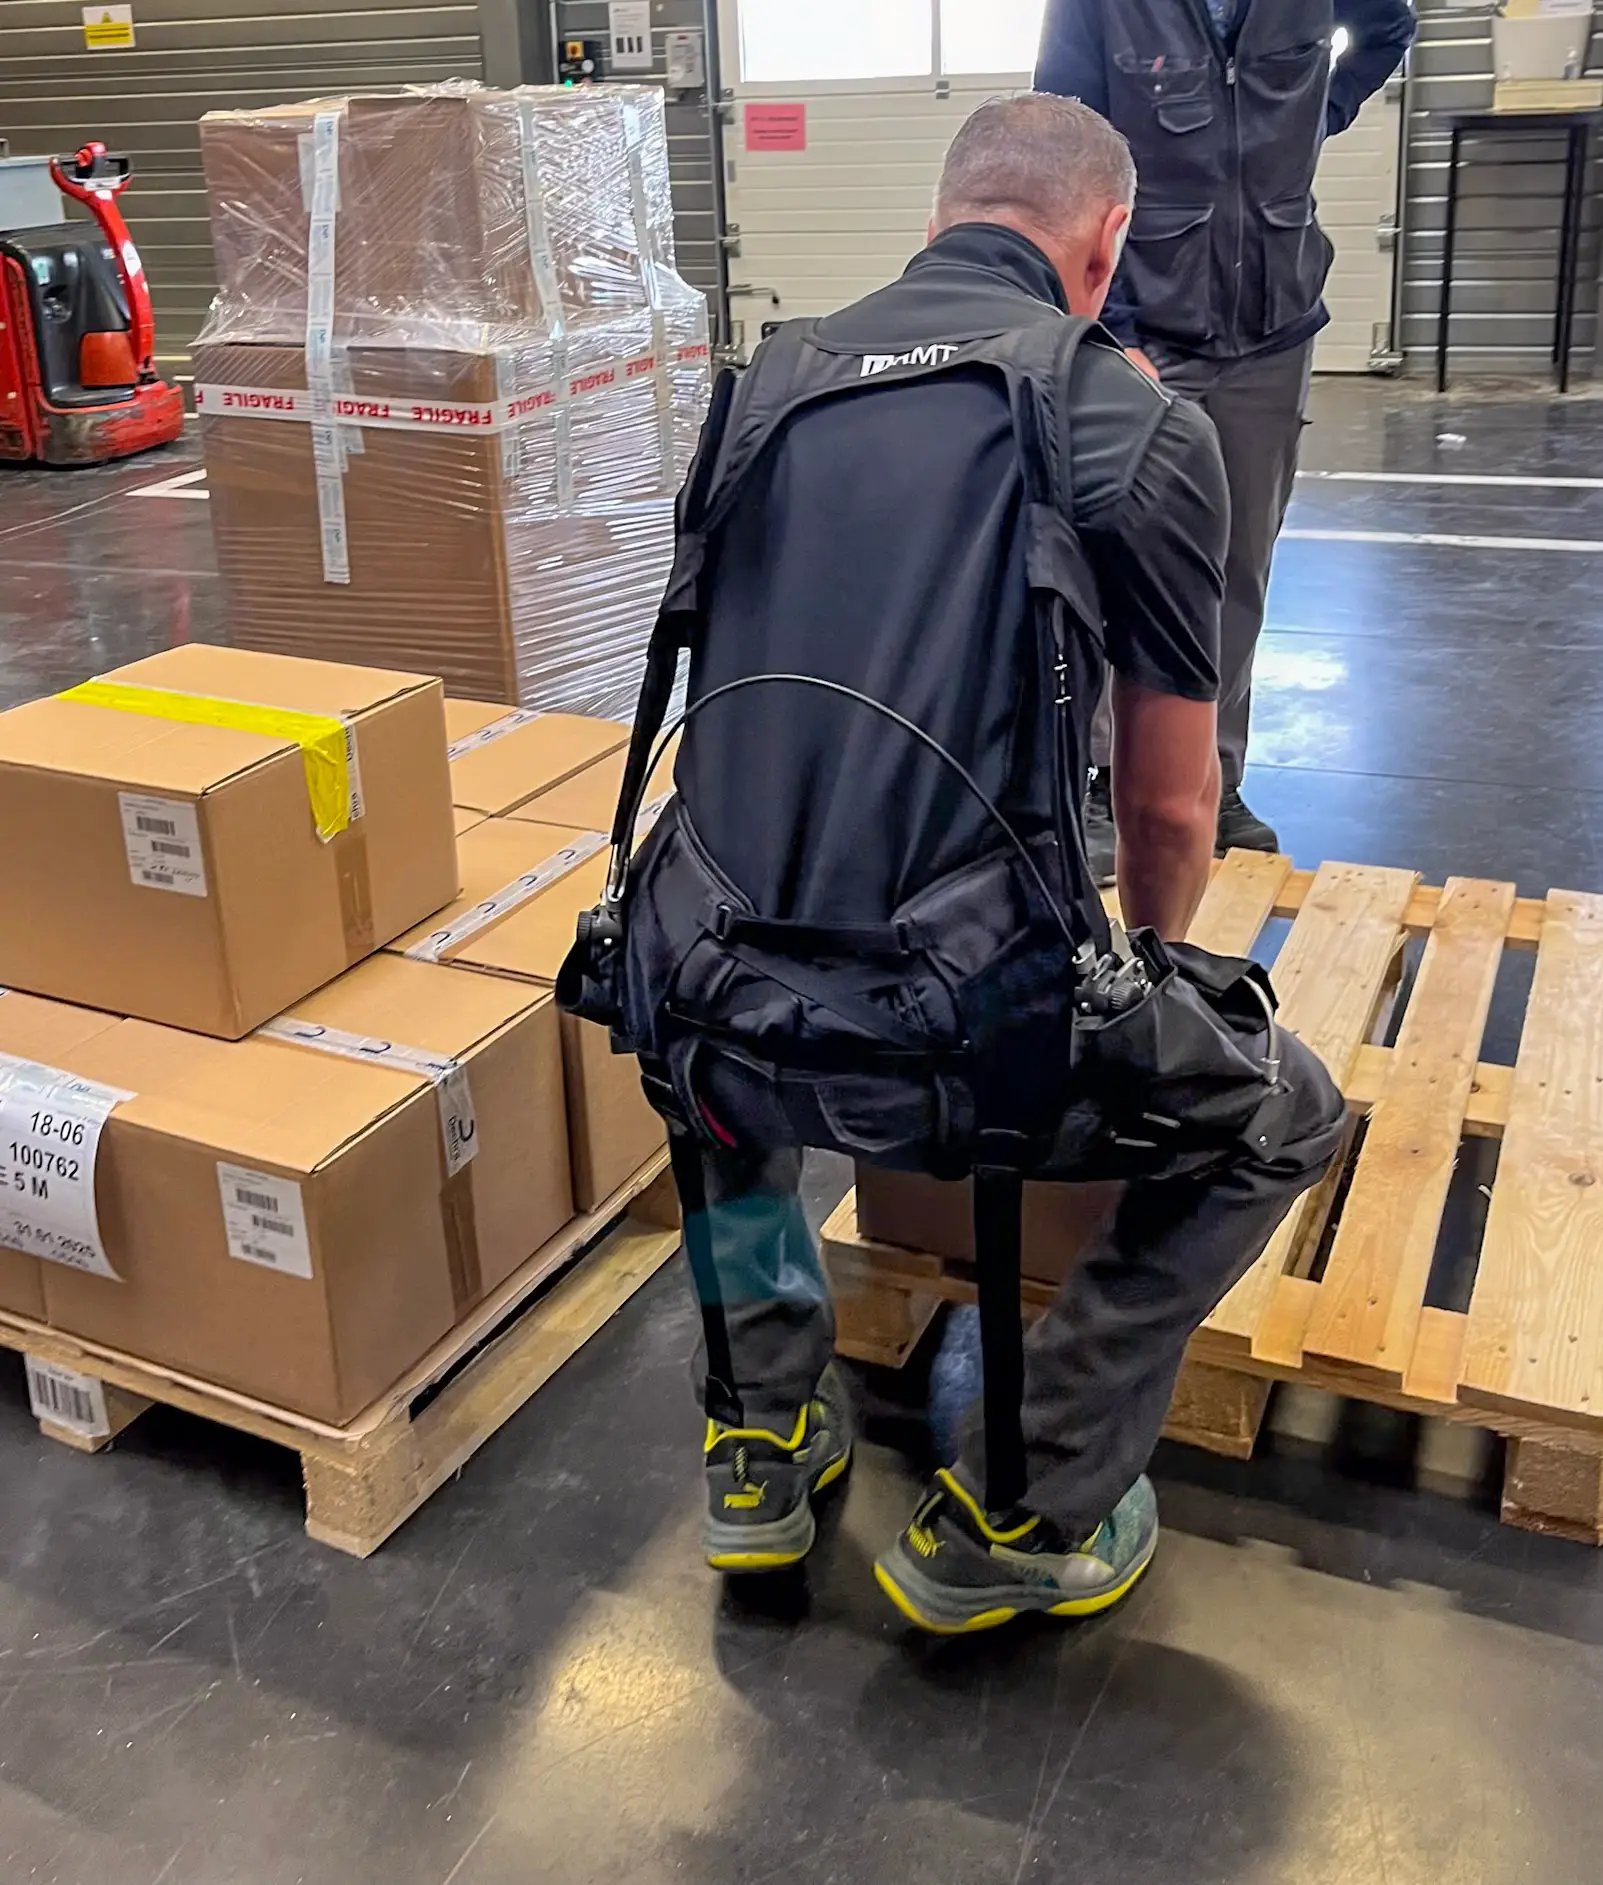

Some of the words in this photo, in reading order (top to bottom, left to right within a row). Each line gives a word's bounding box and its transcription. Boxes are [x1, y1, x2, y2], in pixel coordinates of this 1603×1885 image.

[625, 355, 656, 376] AGILE
[569, 367, 616, 396] FRAGILE
[222, 391, 295, 411] FRAGILE
[335, 400, 390, 418] FRAGI
[410, 405, 492, 425] FRAGILE
[507, 389, 557, 419] FRAGILE
[30, 1110, 86, 1147] 18-06
[9, 1140, 81, 1182] 100762
[14, 1171, 26, 1192] 5
[32, 1176, 49, 1201] M
